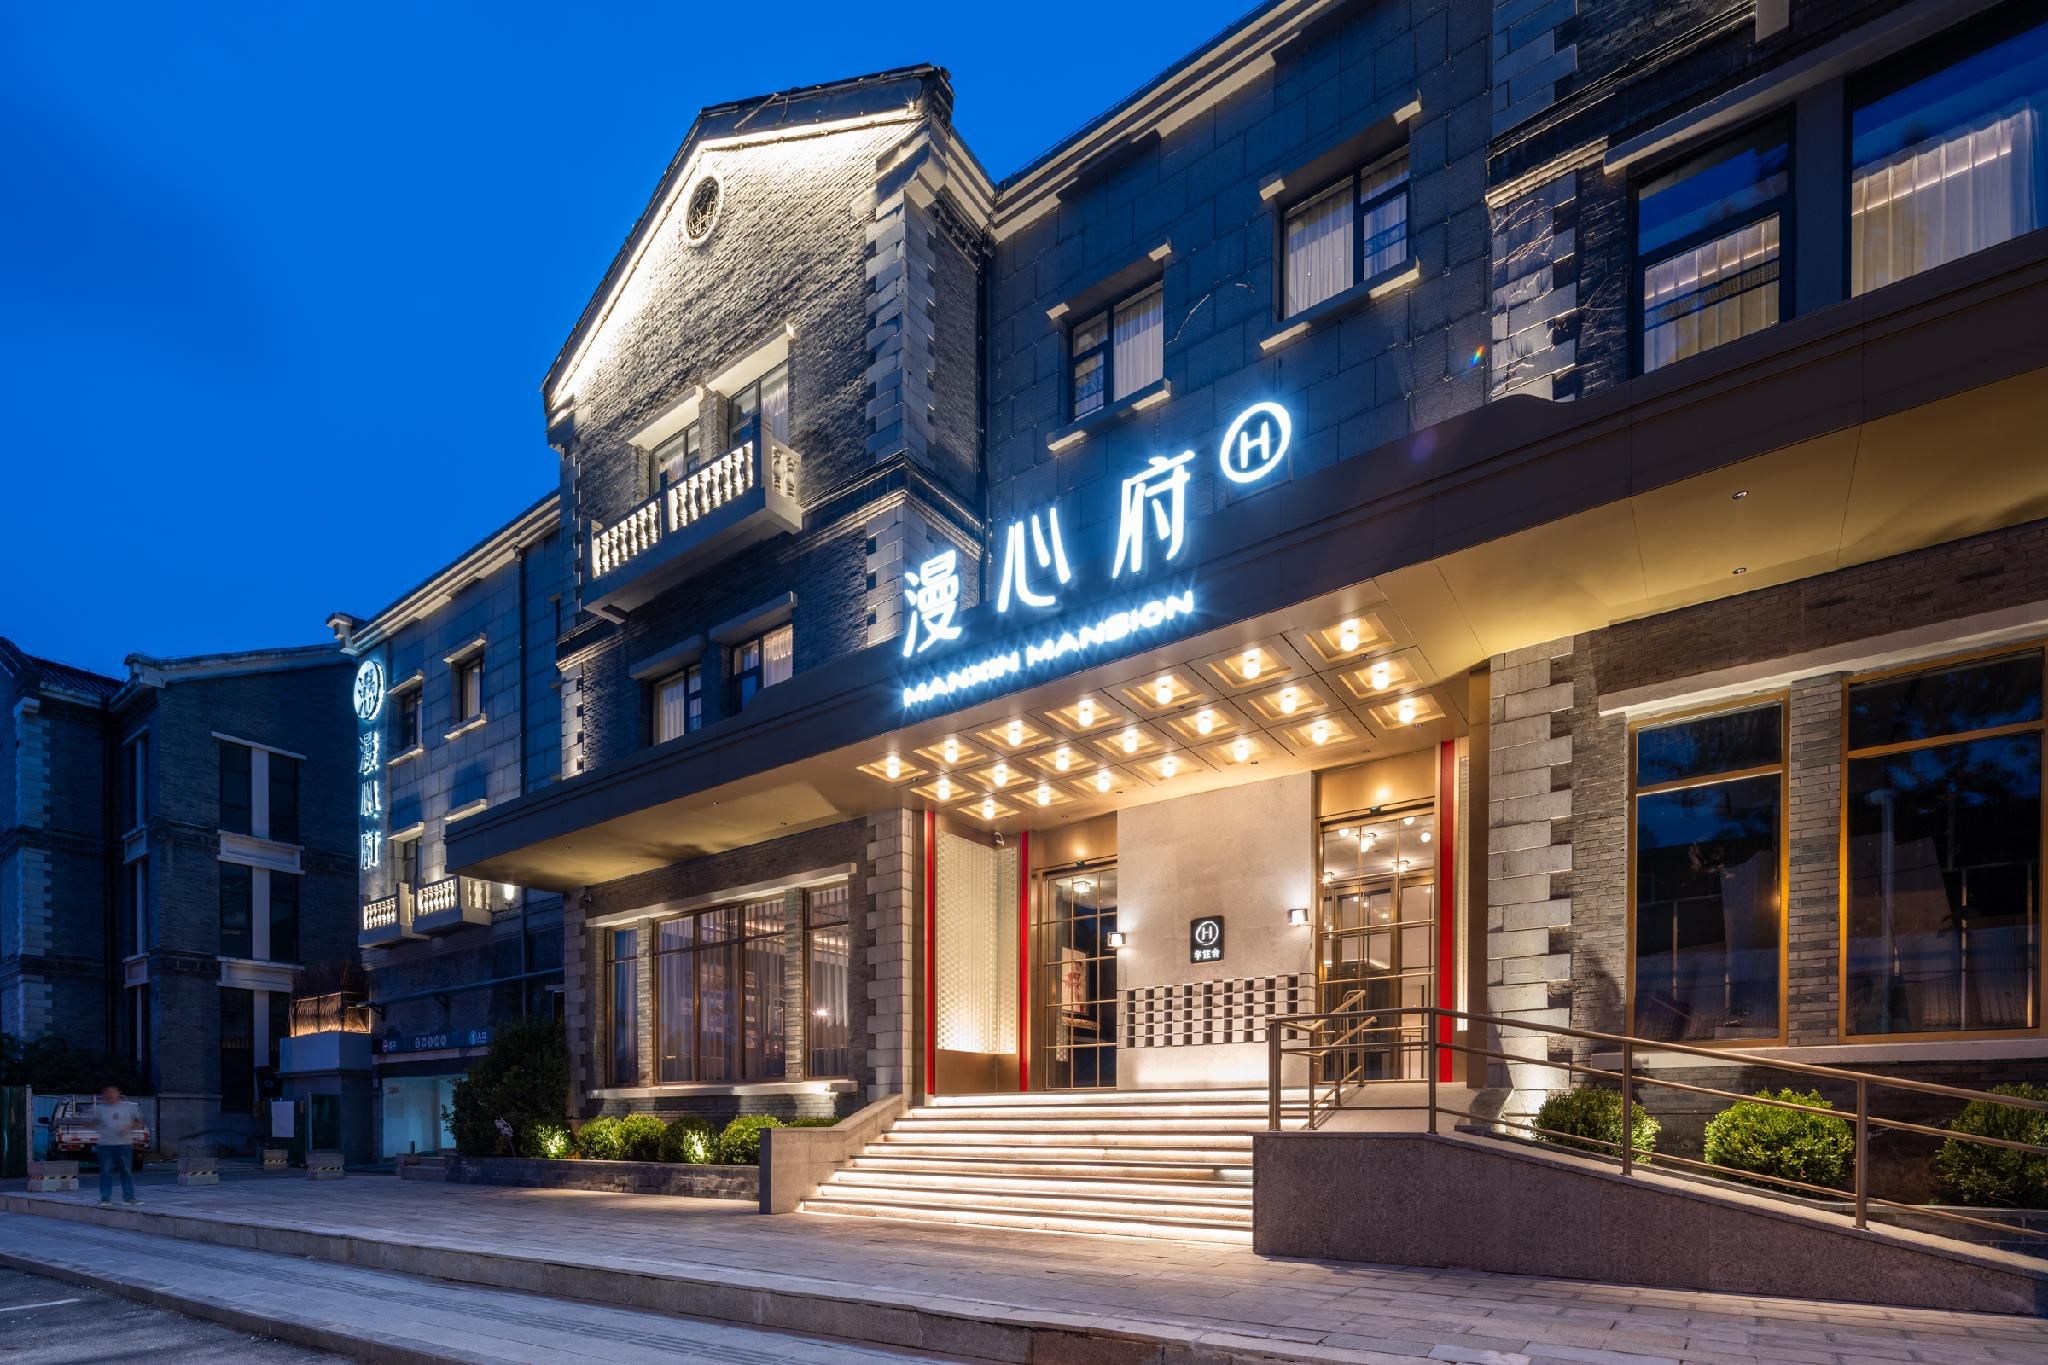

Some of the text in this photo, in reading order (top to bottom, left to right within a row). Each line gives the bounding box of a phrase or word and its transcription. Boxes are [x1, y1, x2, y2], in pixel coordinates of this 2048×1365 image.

[902, 450, 1195, 656] 漫心府
[903, 591, 1195, 707] MANXIN MANSION
[359, 731, 381, 870] 漫心府
